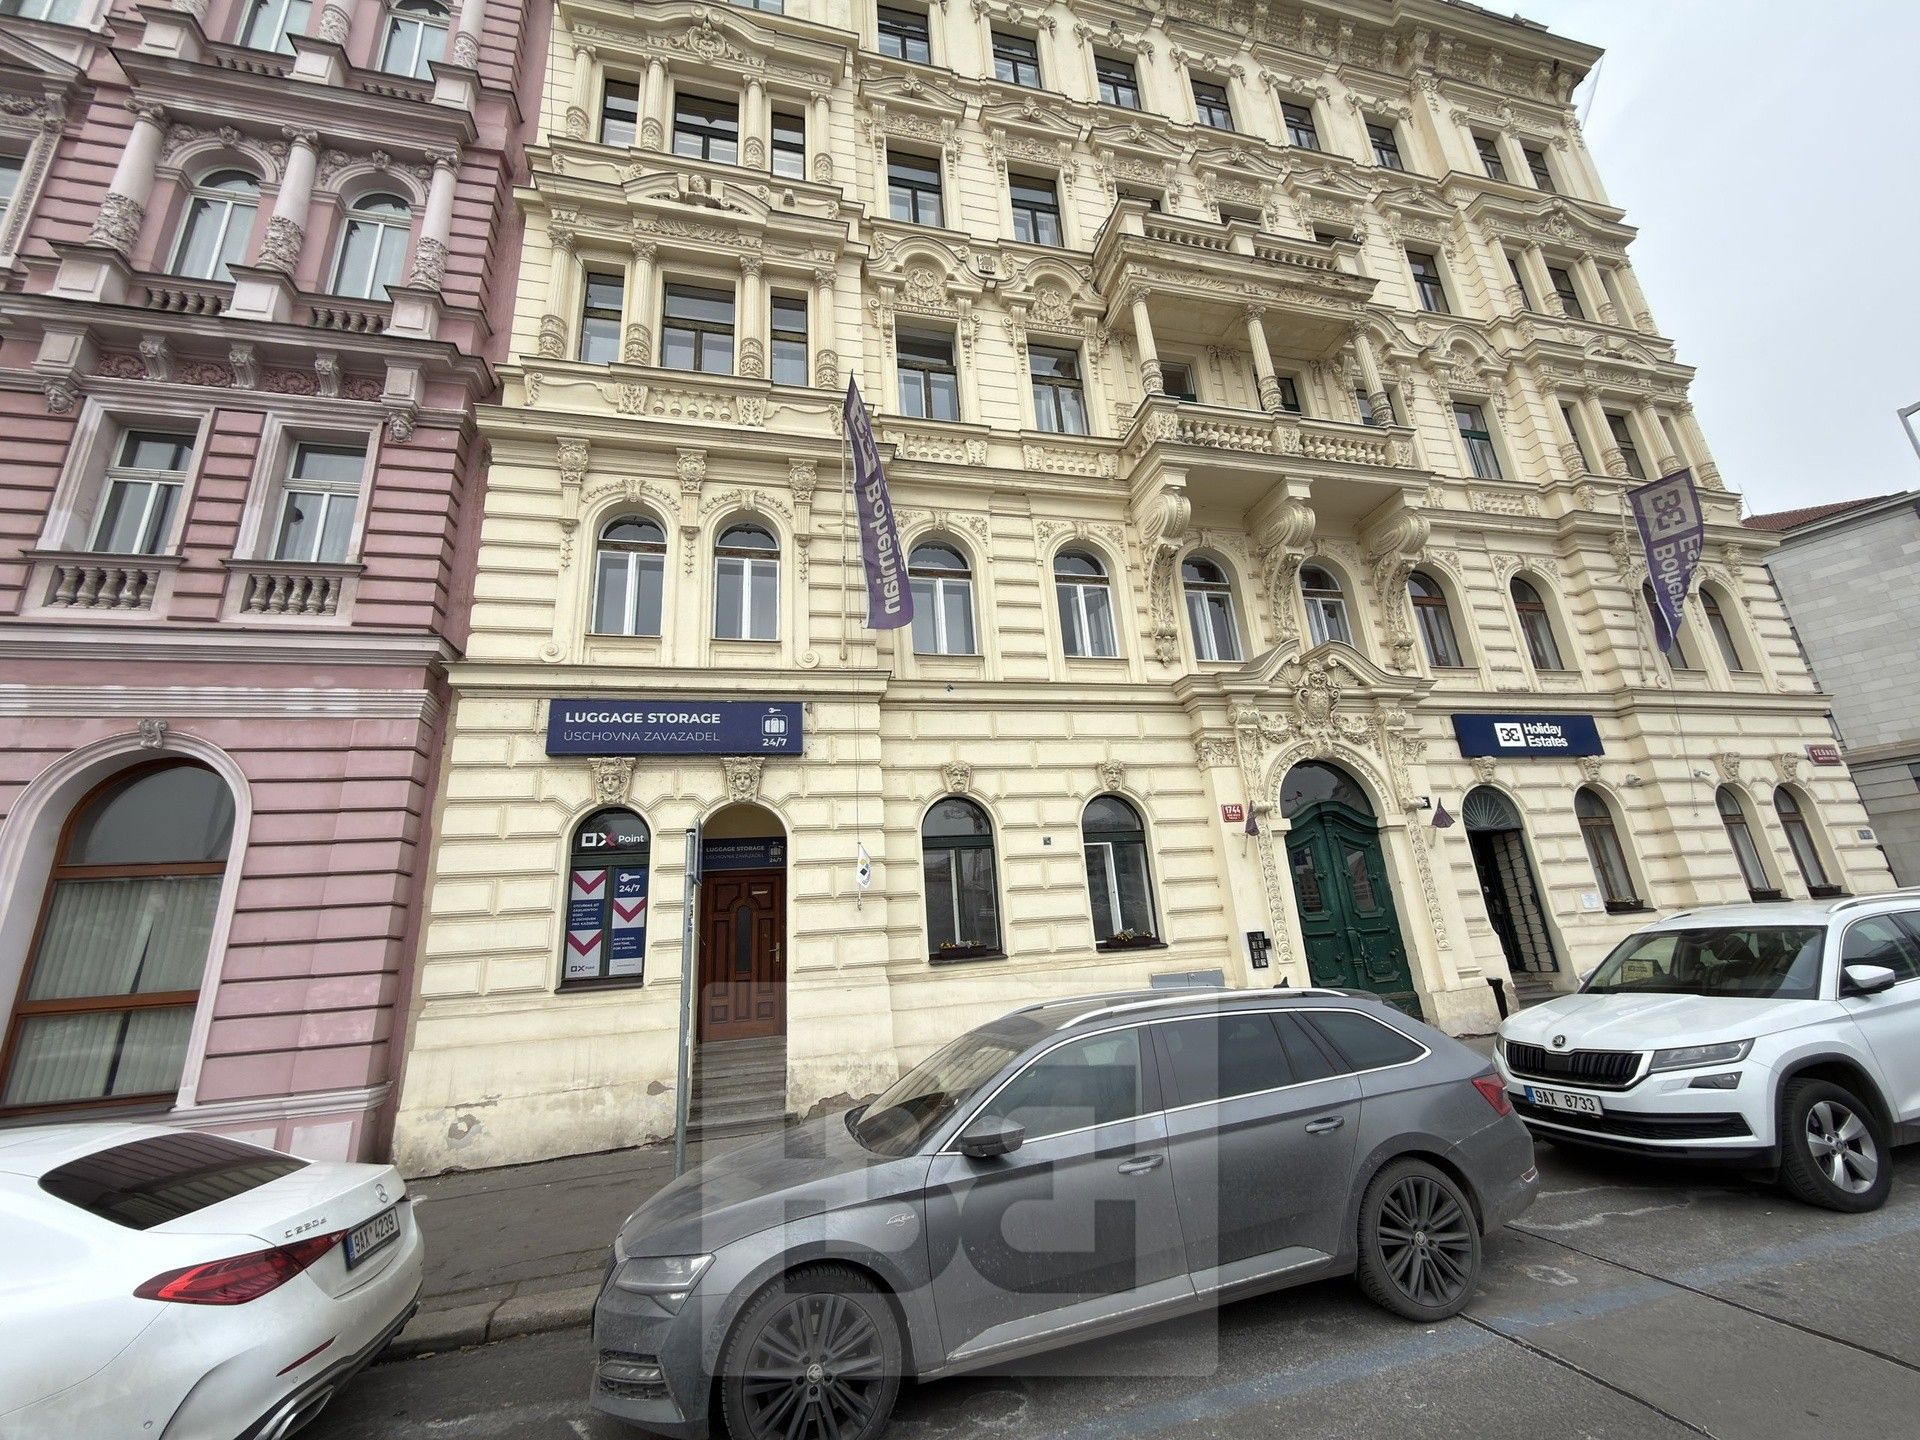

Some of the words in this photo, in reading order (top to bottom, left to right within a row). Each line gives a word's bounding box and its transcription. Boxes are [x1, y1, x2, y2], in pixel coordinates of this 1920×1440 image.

[565, 712, 643, 723] LUGGAGE
[647, 712, 721, 724] STORAGE
[563, 729, 641, 741] ÚSCHOVNA
[643, 731, 720, 742] ZAVAZADEL
[1524, 723, 1561, 736] Holiday
[762, 738, 787, 747] 24/7
[1528, 735, 1568, 747] Estates
[1225, 806, 1241, 814] 1744
[618, 835, 645, 843] Point
[619, 884, 640, 893] 24/7
[1535, 1090, 1557, 1106] 9AX
[1564, 1094, 1595, 1111] 8733
[354, 1230, 371, 1254] 9AX
[374, 1213, 395, 1240] 4239
